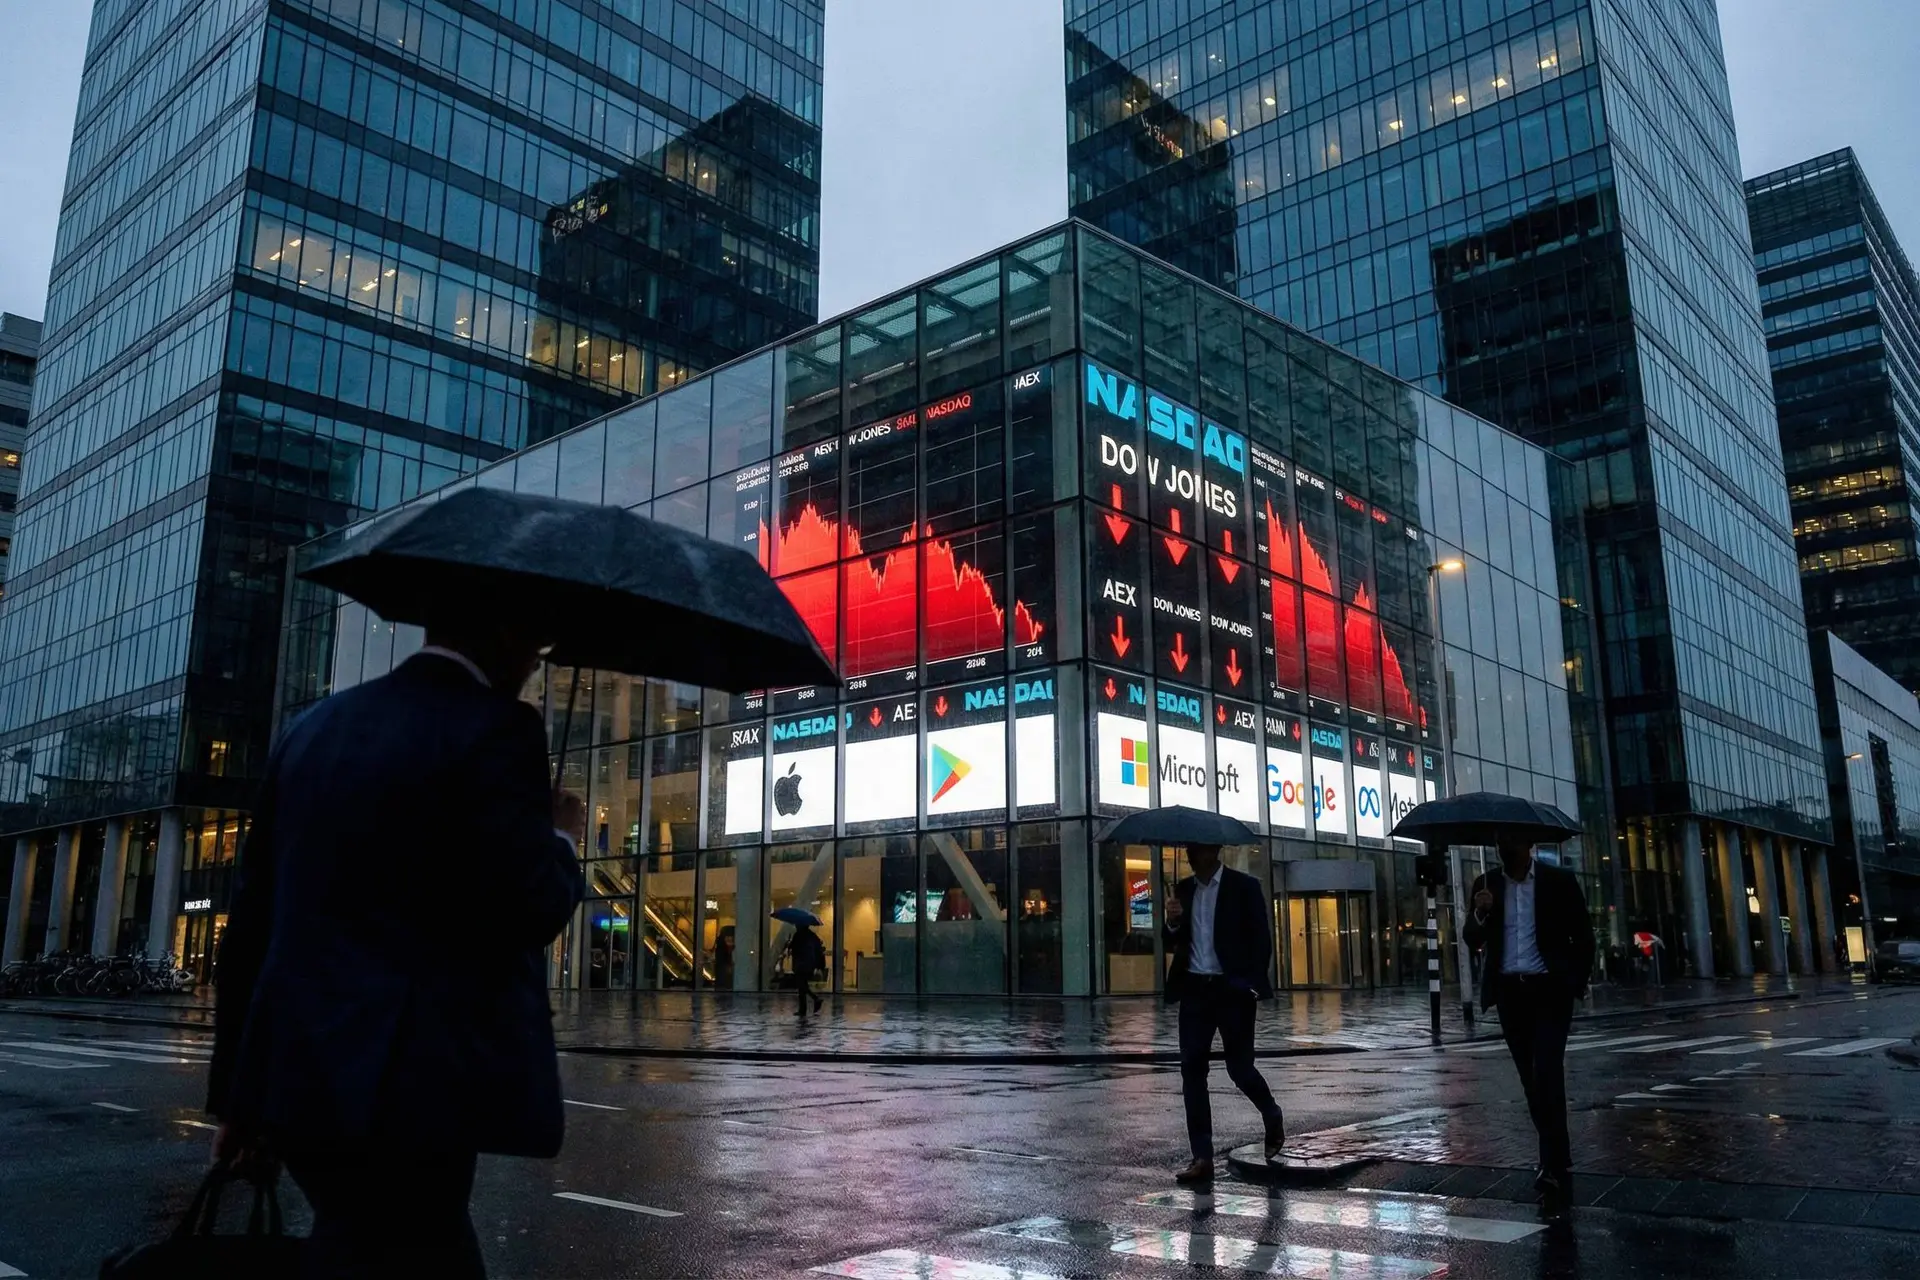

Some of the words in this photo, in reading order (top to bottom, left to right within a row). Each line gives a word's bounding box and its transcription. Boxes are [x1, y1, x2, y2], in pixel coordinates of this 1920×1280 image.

[926, 394, 971, 419] NASDAQ
[1088, 364, 1245, 482] NASDAQ
[858, 422, 892, 443] JONES
[1165, 464, 1237, 519] JONES
[1103, 578, 1137, 608] AEX
[1234, 710, 1255, 730] AEX
[1160, 754, 1240, 794] Microoft
[1268, 763, 1337, 820] Google
